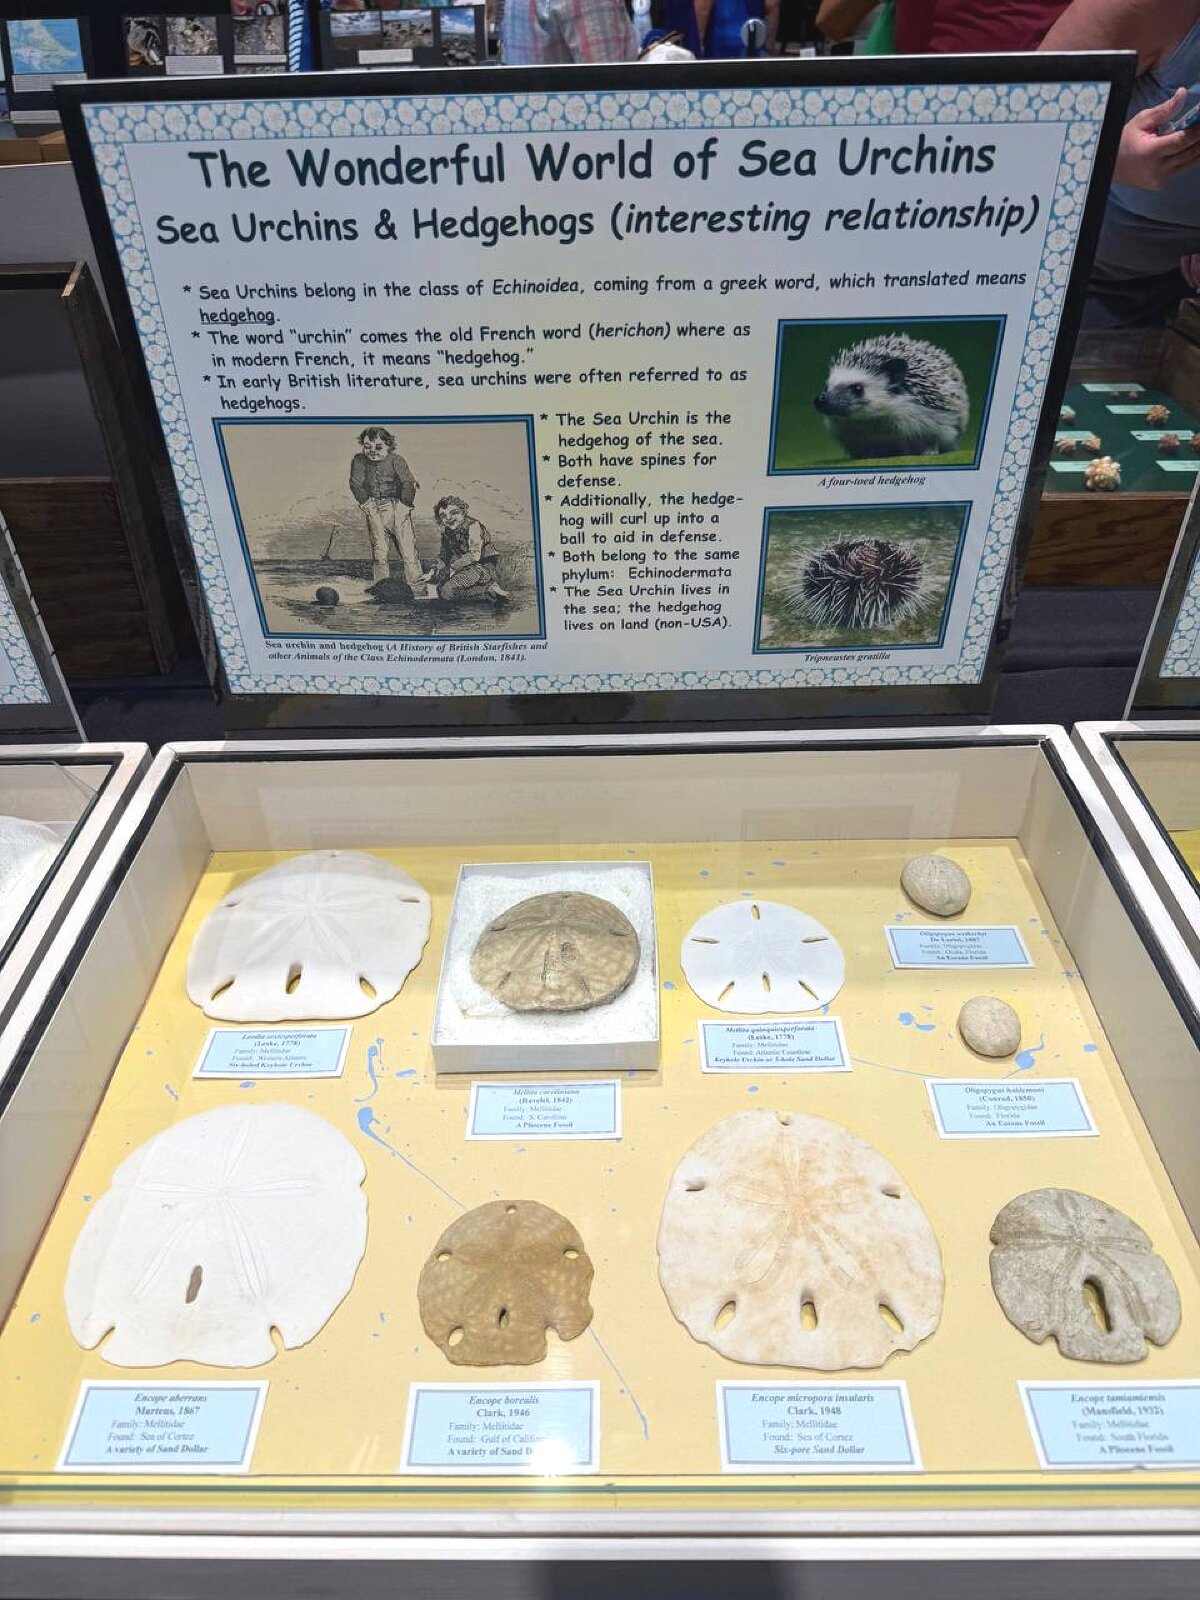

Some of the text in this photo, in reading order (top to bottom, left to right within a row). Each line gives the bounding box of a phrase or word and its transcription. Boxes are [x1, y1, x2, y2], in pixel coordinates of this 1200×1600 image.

[188, 133, 996, 188] The Wonderful World of Sea Urchins
[157, 195, 1039, 247] Sea Urchins & Hedgehogs (interesting relationship)
[200, 270, 1026, 301] Sea Urchins belong in the class of Echinoidea, coming from a greek word, which translated means
[200, 307, 280, 326] hedgehog.
[207, 321, 750, 344] The word “urchin” comes the old French word (herichon) where as
[211, 347, 534, 368] in modern French, it means “hedgehog.”
[217, 367, 747, 391] In early British literature, sea urchins were often referred to as
[220, 395, 305, 413] hedgehogs.
[556, 410, 731, 426] The Sea Urchin is the
[559, 431, 722, 450] hedgehog of the sea.
[559, 452, 716, 469] Both have spines for
[557, 474, 621, 488] defense.
[818, 475, 925, 489] A four-toed hedgehog
[561, 491, 743, 509] Additionally, the hedge-
[560, 511, 719, 529] hog will curl up into a
[560, 530, 722, 544] ball to aid in defense.
[563, 548, 739, 564] Both belong to the same
[562, 566, 731, 583] phylum: Echinodermata
[564, 584, 729, 597] The Sea Urchin lives in
[564, 601, 721, 615] the sea; the hedgehog
[565, 616, 731, 630] lives on land (non-USA).
[286, 641, 315, 649] urchin
[340, 642, 384, 651] hedgehog
[387, 643, 396, 651] (A
[400, 643, 433, 653] History
[436, 644, 445, 652] of
[449, 643, 479, 651] British
[483, 642, 526, 652] Starfishes
[787, 1406, 841, 1415] Clark, 1948
